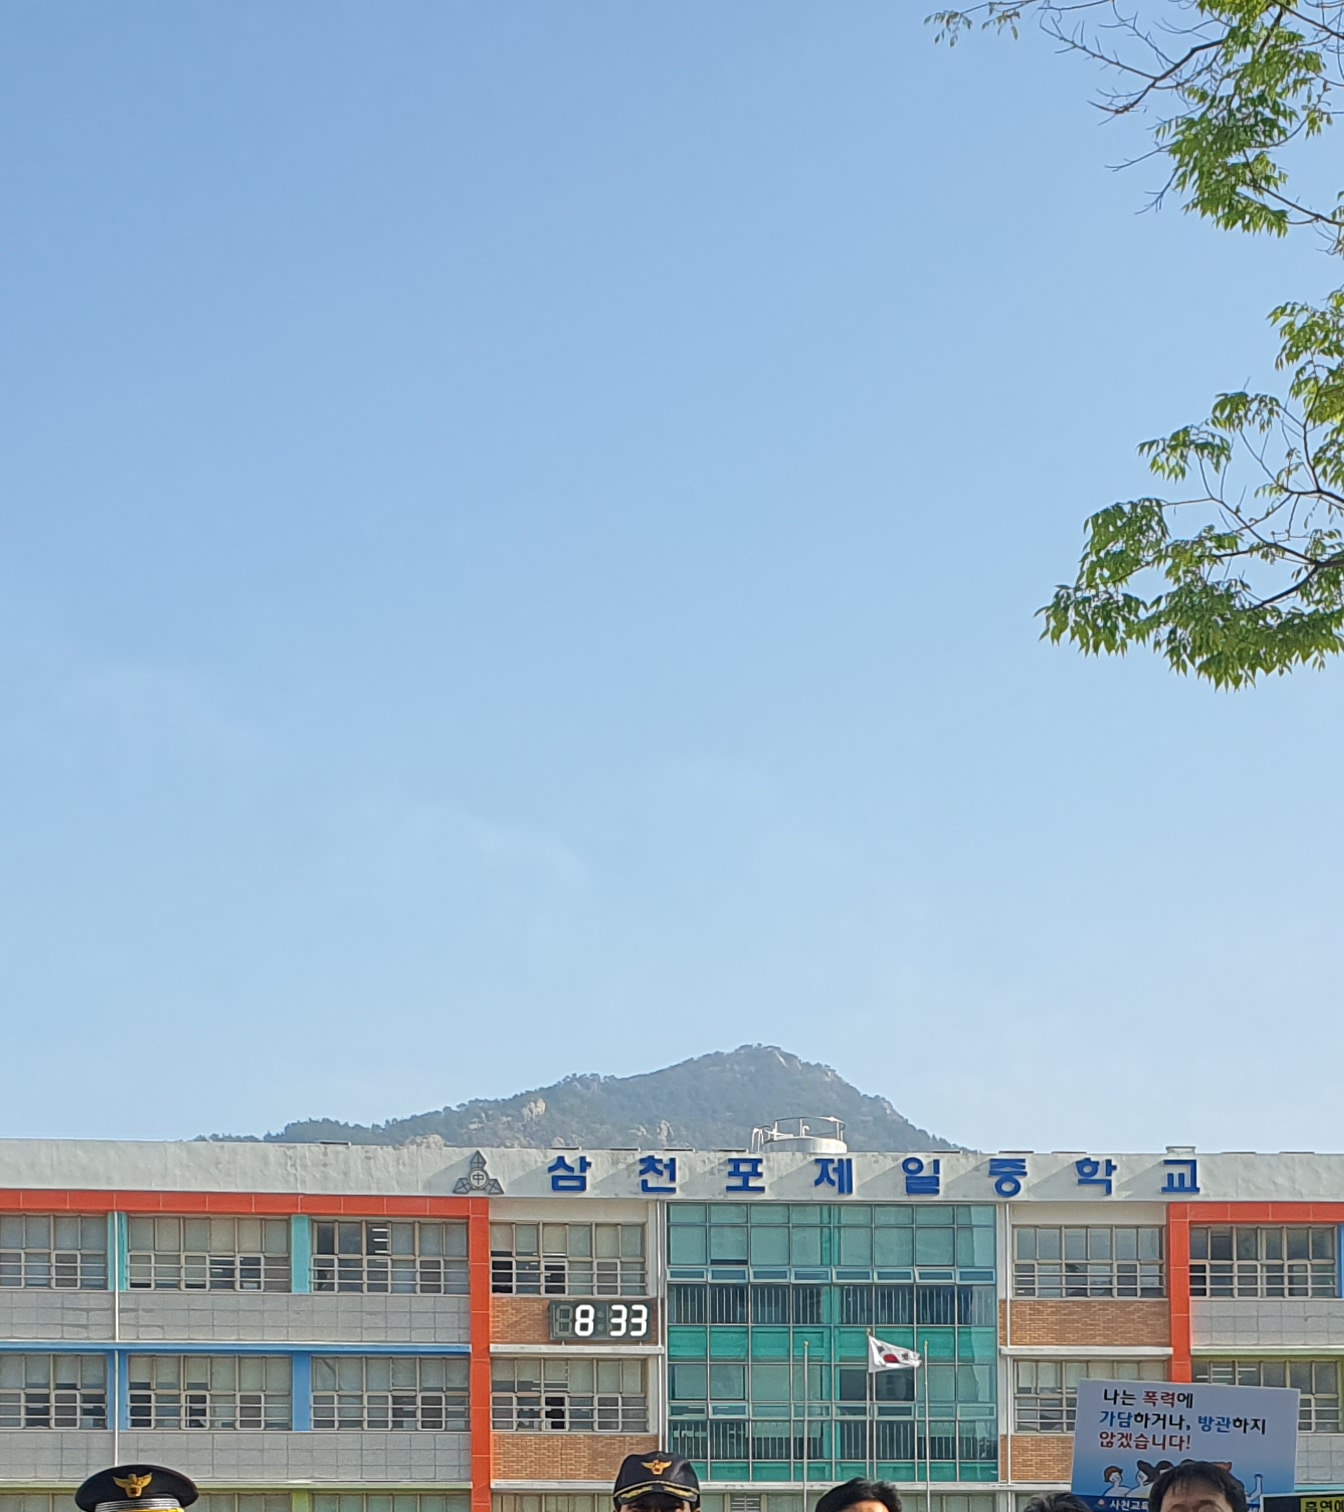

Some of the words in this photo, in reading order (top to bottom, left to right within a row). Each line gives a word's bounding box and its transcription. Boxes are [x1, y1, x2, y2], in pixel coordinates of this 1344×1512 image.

[547, 1155, 1201, 1198] 삼천포제일중학교
[1103, 1388, 1137, 1407] 나는
[1141, 1390, 1195, 1409] 폭력에
[1099, 1410, 1192, 1432] 가담하거나,
[1197, 1415, 1267, 1435] 방관하지
[1099, 1431, 1192, 1452] 않겠습니다!
[1109, 1499, 1150, 1512] 사천교육
